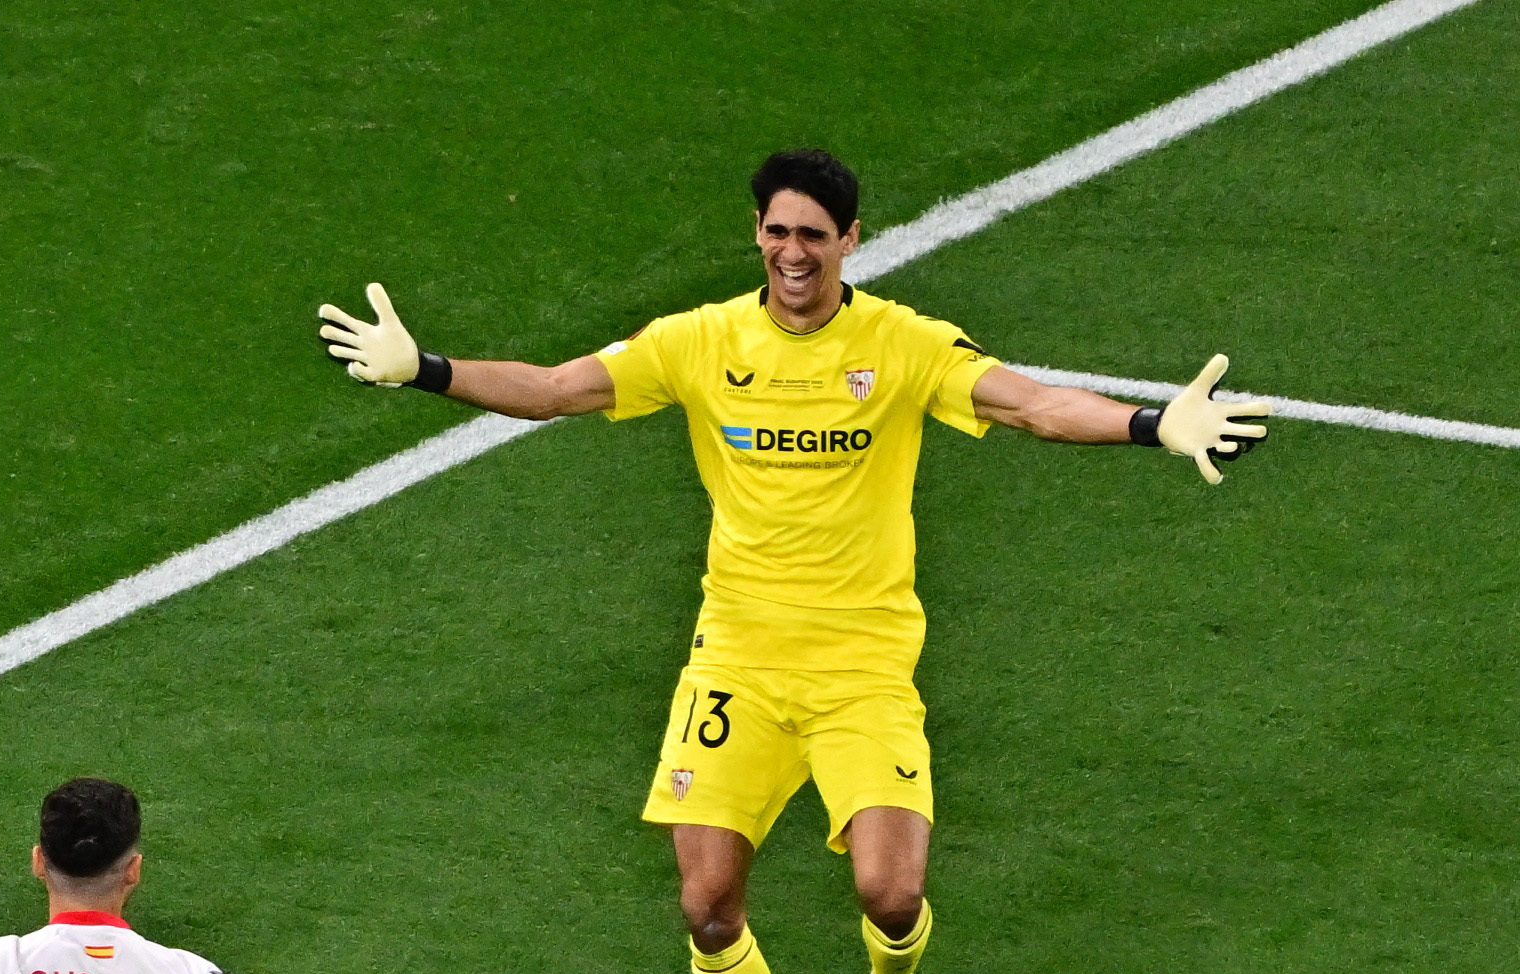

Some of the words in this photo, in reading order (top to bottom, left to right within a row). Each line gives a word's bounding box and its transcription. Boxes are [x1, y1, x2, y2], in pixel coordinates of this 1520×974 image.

[756, 428, 872, 453] DEGIRO
[776, 460, 821, 469] LEADING
[824, 458, 866, 469] BROKER
[682, 687, 735, 749] 13
